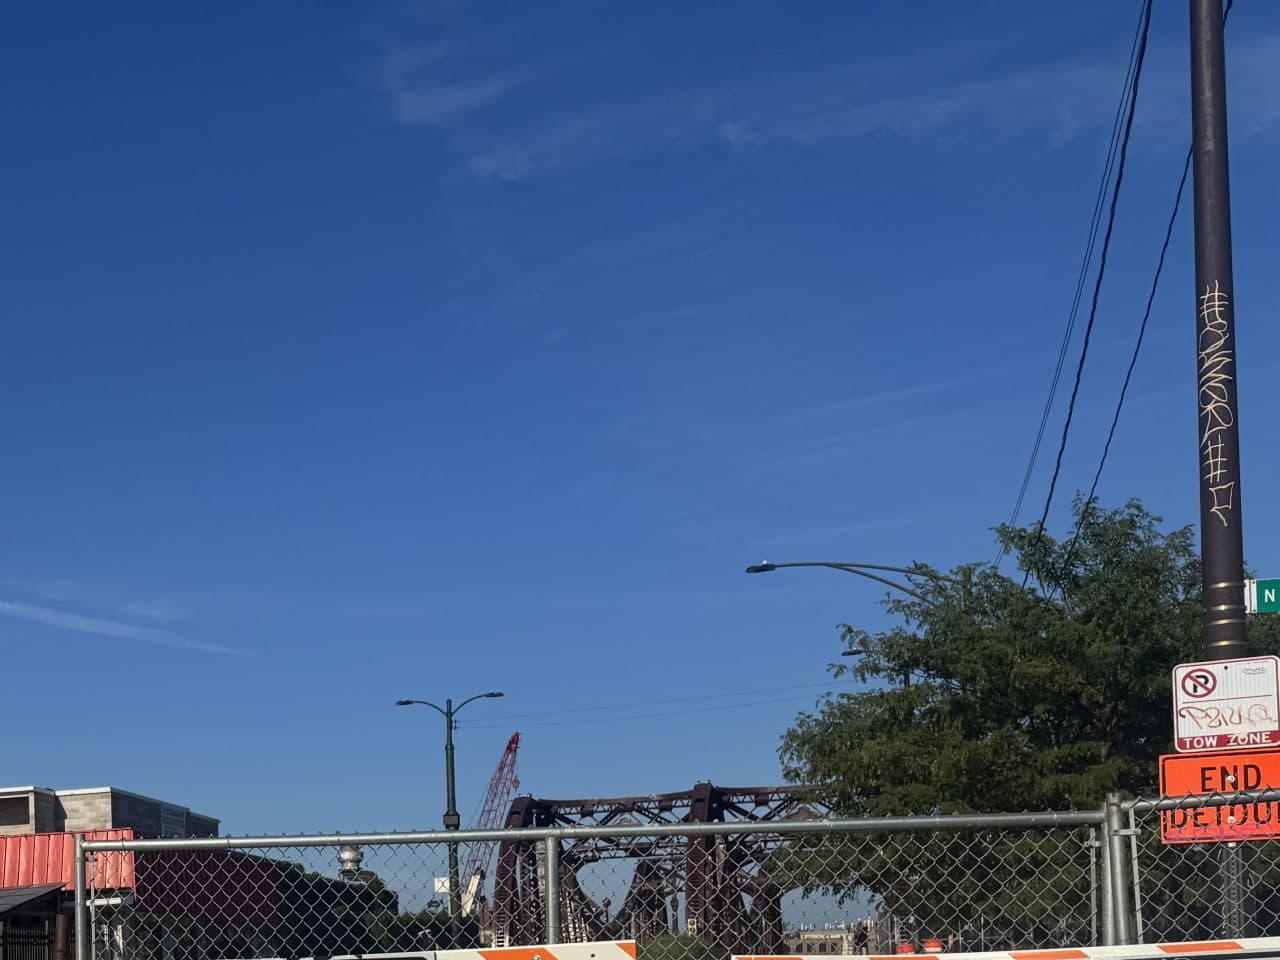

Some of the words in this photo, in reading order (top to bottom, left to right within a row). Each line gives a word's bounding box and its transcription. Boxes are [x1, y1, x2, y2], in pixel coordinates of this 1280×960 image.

[1264, 589, 1275, 602] N
[1184, 736, 1217, 749] TOW
[1227, 731, 1272, 746] ZONE
[1201, 764, 1261, 792] END
[1170, 801, 1280, 829] DETOU
